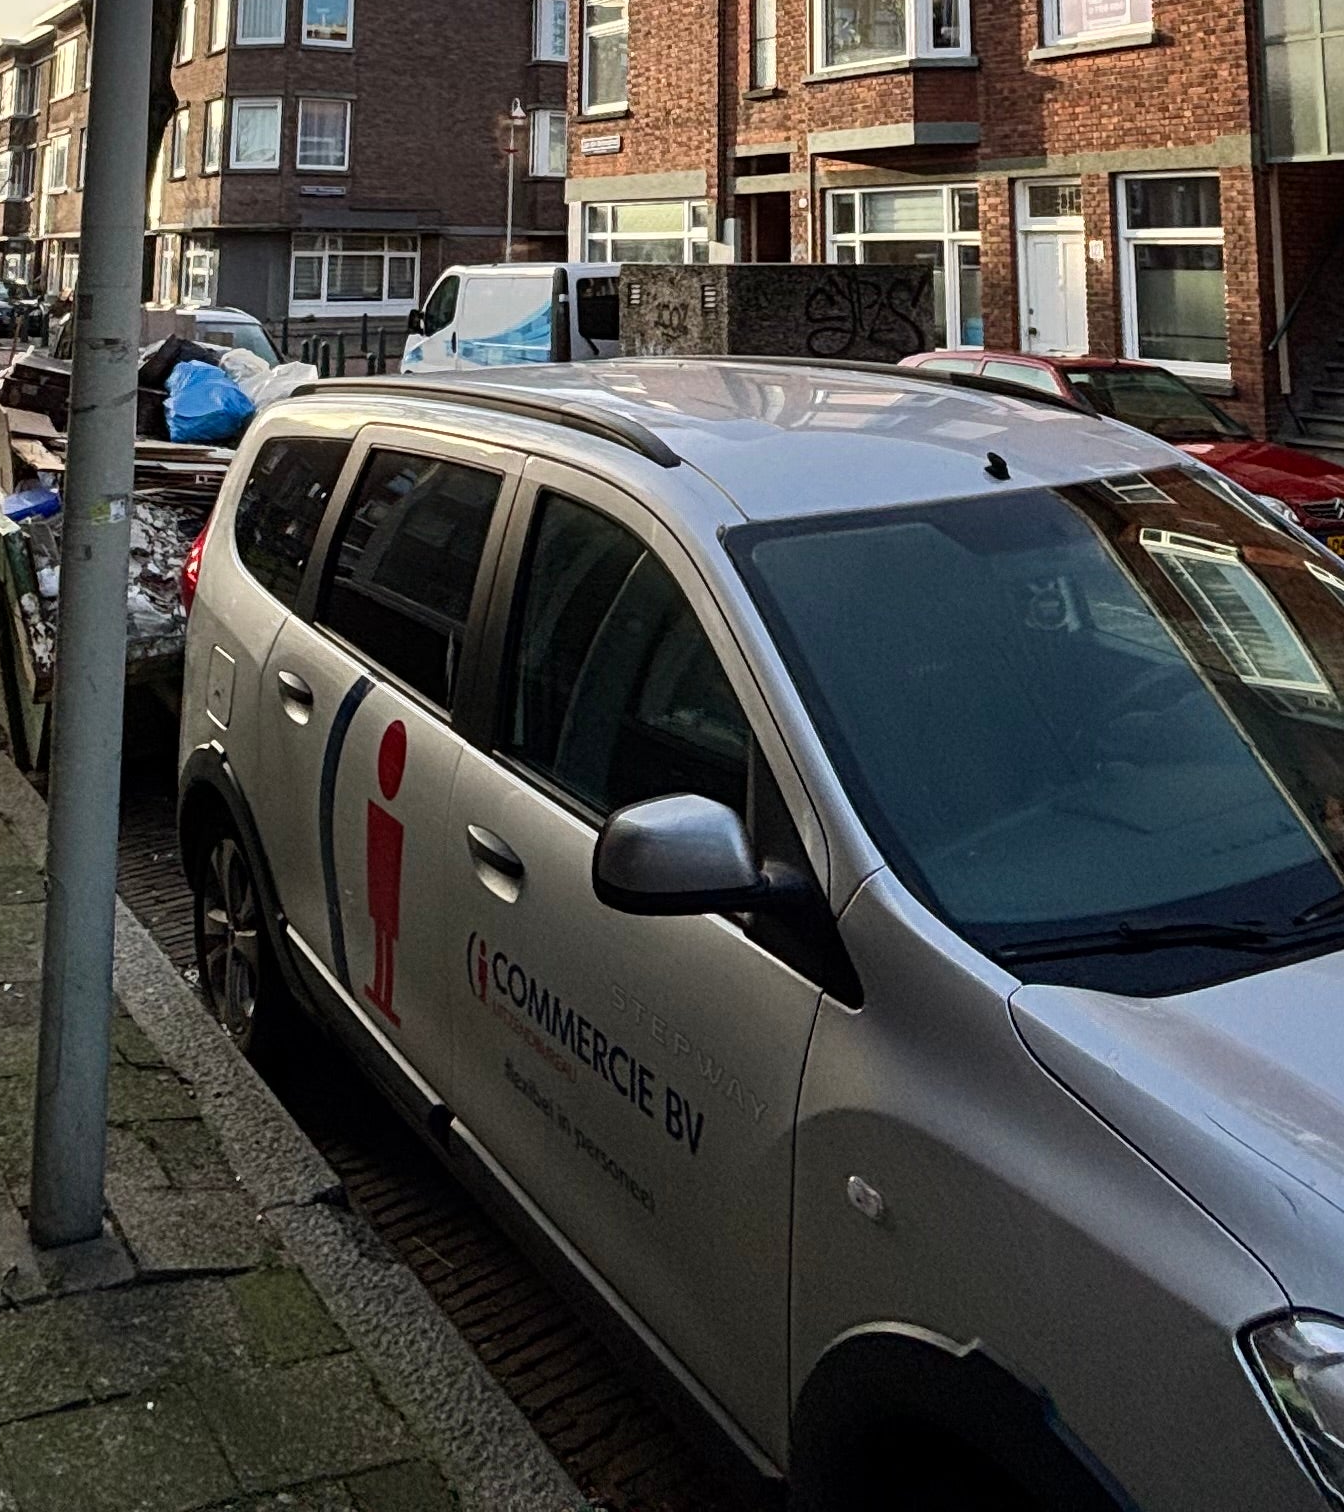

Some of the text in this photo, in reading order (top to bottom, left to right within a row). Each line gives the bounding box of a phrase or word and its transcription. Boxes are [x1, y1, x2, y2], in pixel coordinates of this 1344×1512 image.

[492, 951, 655, 1119] COMMERCIE
[665, 1087, 704, 1156] BV
[611, 983, 769, 1124] STEPWAY
